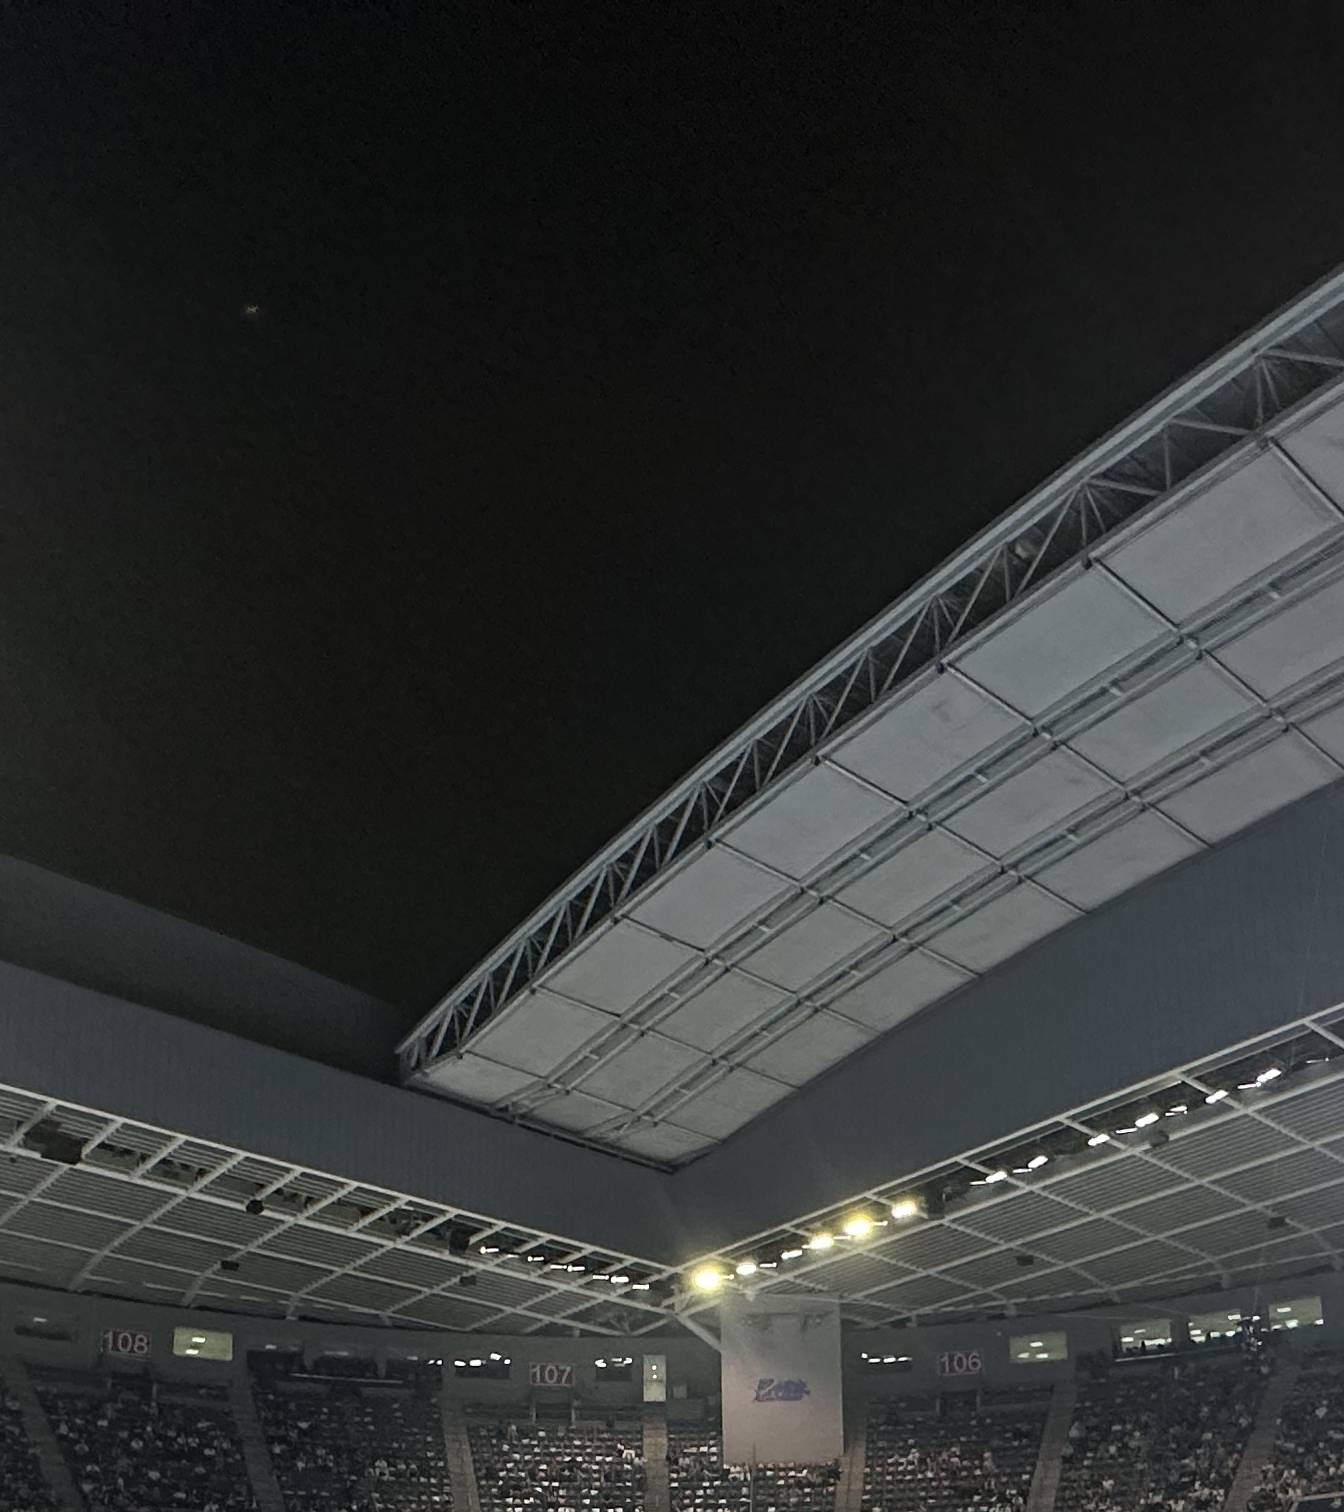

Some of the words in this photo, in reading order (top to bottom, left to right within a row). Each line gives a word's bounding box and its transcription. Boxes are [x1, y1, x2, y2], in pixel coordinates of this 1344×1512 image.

[103, 1332, 148, 1354] 108
[940, 1351, 982, 1373] 106
[531, 1364, 572, 1385] 107
